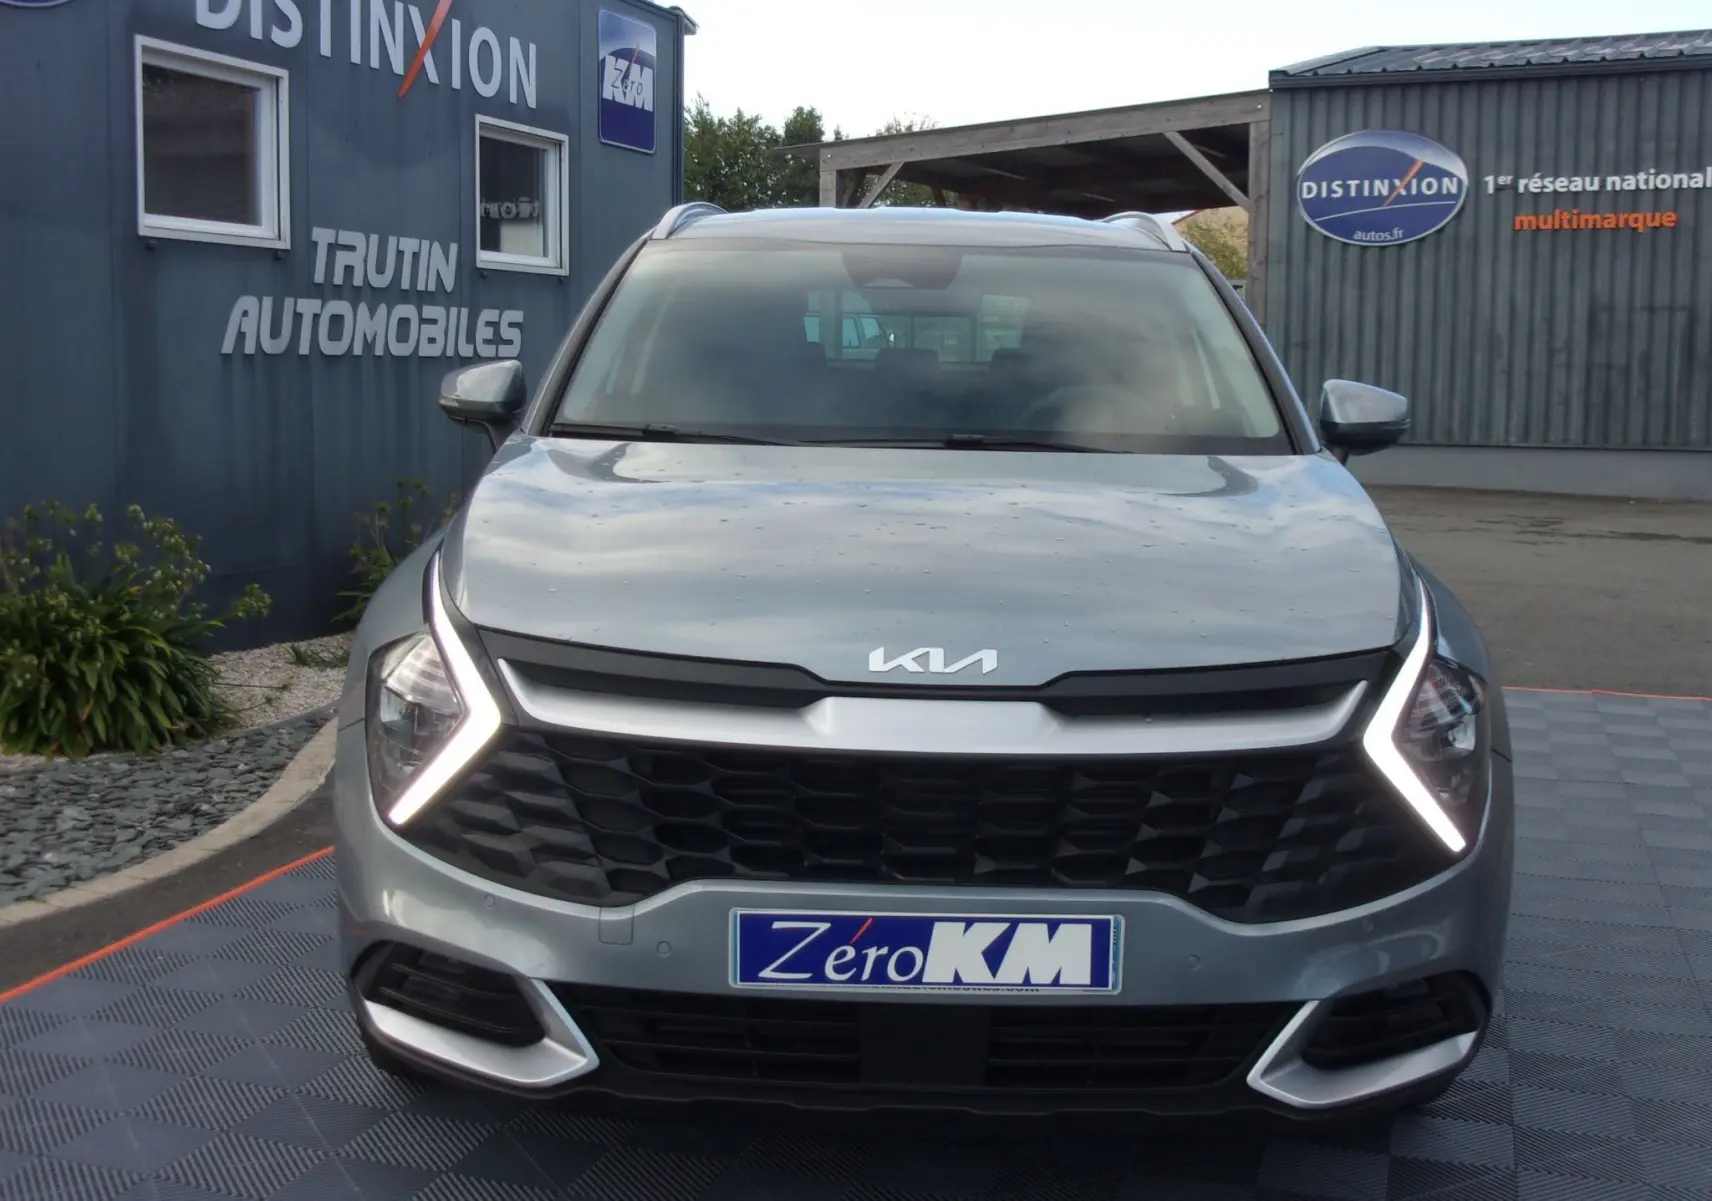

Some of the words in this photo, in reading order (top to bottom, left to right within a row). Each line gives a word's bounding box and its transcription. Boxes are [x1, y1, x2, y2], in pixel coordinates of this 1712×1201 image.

[1518, 171, 1599, 192] réseau
[1606, 166, 1712, 191] national
[1514, 209, 1676, 232] multimarque
[1353, 227, 1404, 243] autos.fr
[311, 227, 458, 292] TRUTIN
[220, 295, 524, 357] AUTOMOBILES
